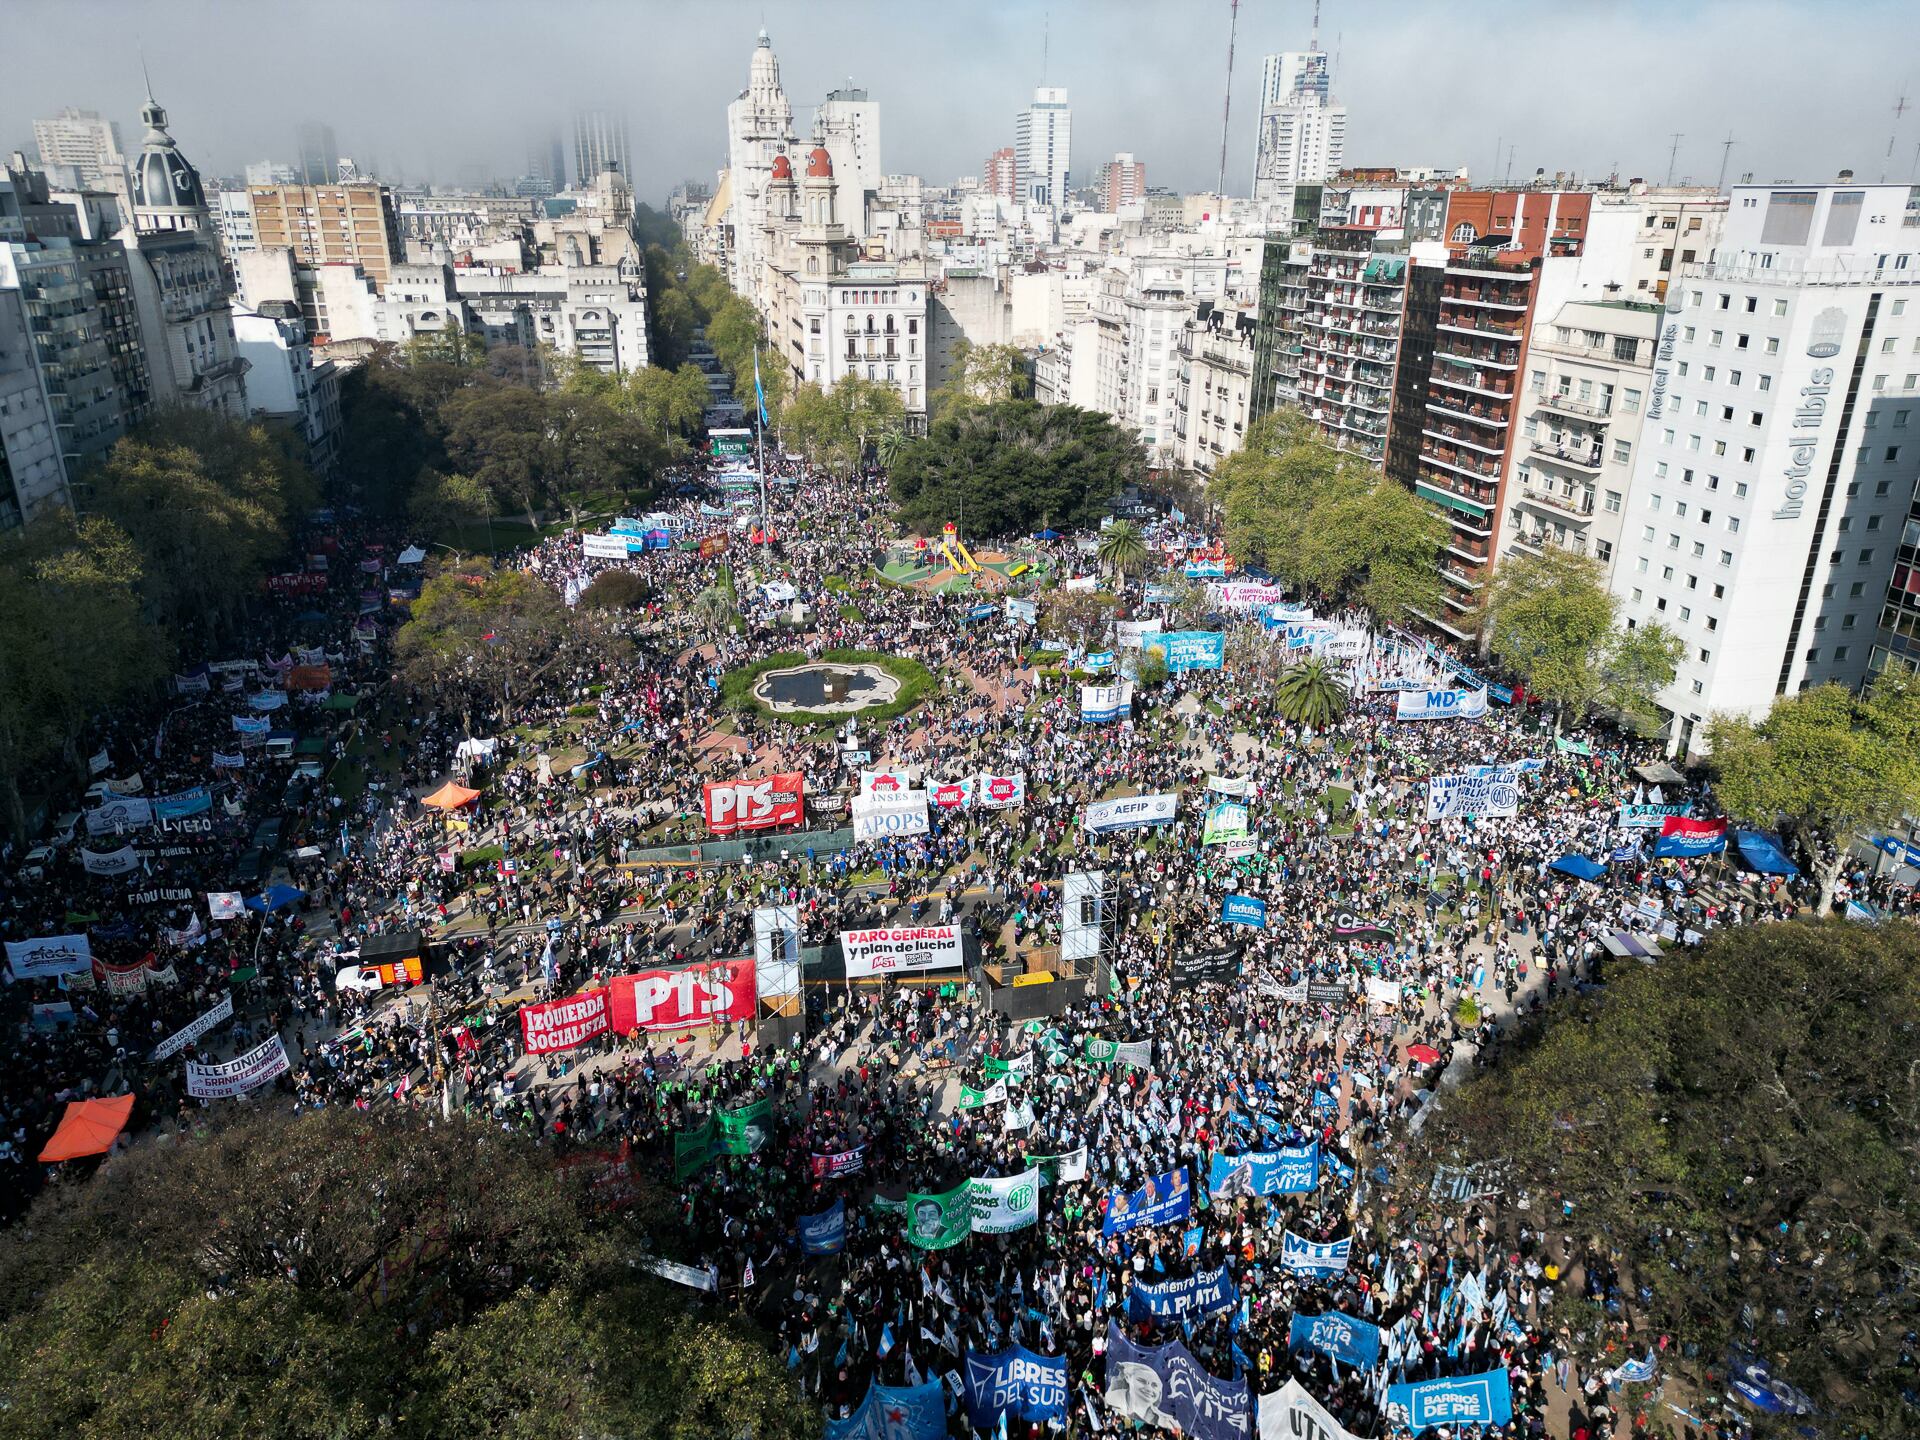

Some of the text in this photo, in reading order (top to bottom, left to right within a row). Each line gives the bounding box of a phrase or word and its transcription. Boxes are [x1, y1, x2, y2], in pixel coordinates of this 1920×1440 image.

[1772, 366, 1834, 521] hotel ibis
[1170, 645, 1206, 656] PATRIA
[1170, 653, 1216, 664] FUTURO
[1380, 678, 1420, 689] LEALTAD
[1432, 774, 1516, 788] SINDICATO SALUD
[940, 791, 958, 802] COOKE
[994, 784, 1010, 794] COOKE
[1456, 786, 1490, 797] PUBLICA
[710, 780, 774, 822] PTS
[870, 792, 909, 802] ANSES
[1114, 802, 1149, 814] AEFIP
[1629, 804, 1681, 818] SANIDA
[116, 822, 136, 835] NO
[172, 818, 212, 833] VETO
[861, 812, 924, 835] APOPS
[1679, 836, 1718, 844] GRANDE
[1684, 829, 1719, 838] FRENTE
[128, 888, 192, 905] FADU LUCHA
[1228, 902, 1262, 917] feduba
[1338, 913, 1390, 929] CEO
[848, 927, 954, 944] PARO GENERAL
[849, 940, 956, 960] y plan de lucha
[872, 956, 896, 969] MST
[1185, 961, 1212, 972] SOCIALES
[634, 966, 734, 1024] PTS
[525, 995, 605, 1032] IZQUIERDA
[176, 1030, 188, 1040] LOS
[189, 1017, 208, 1032] VETOS
[526, 1012, 608, 1051] SOCIALISTA
[189, 1038, 276, 1076] TELEFONICOS
[192, 1086, 233, 1094] FOETRA
[832, 1152, 862, 1162] MTL
[1265, 1162, 1312, 1177] movimiento
[1113, 1196, 1182, 1224] ACA NO SE RINDE NADIE
[911, 1237, 940, 1249] CONSEJO
[1284, 1232, 1350, 1258] MTE
[1291, 1268, 1318, 1277] ABA
[1151, 1299, 1171, 1316] LA
[1174, 1284, 1222, 1314] PLATA
[995, 1358, 1066, 1388] LIBRES
[1168, 1356, 1248, 1406] movimiento
[993, 1382, 1066, 1408] DEL SUR
[1424, 1393, 1479, 1405] BARRIOS
[1424, 1404, 1480, 1418] DE PIE
